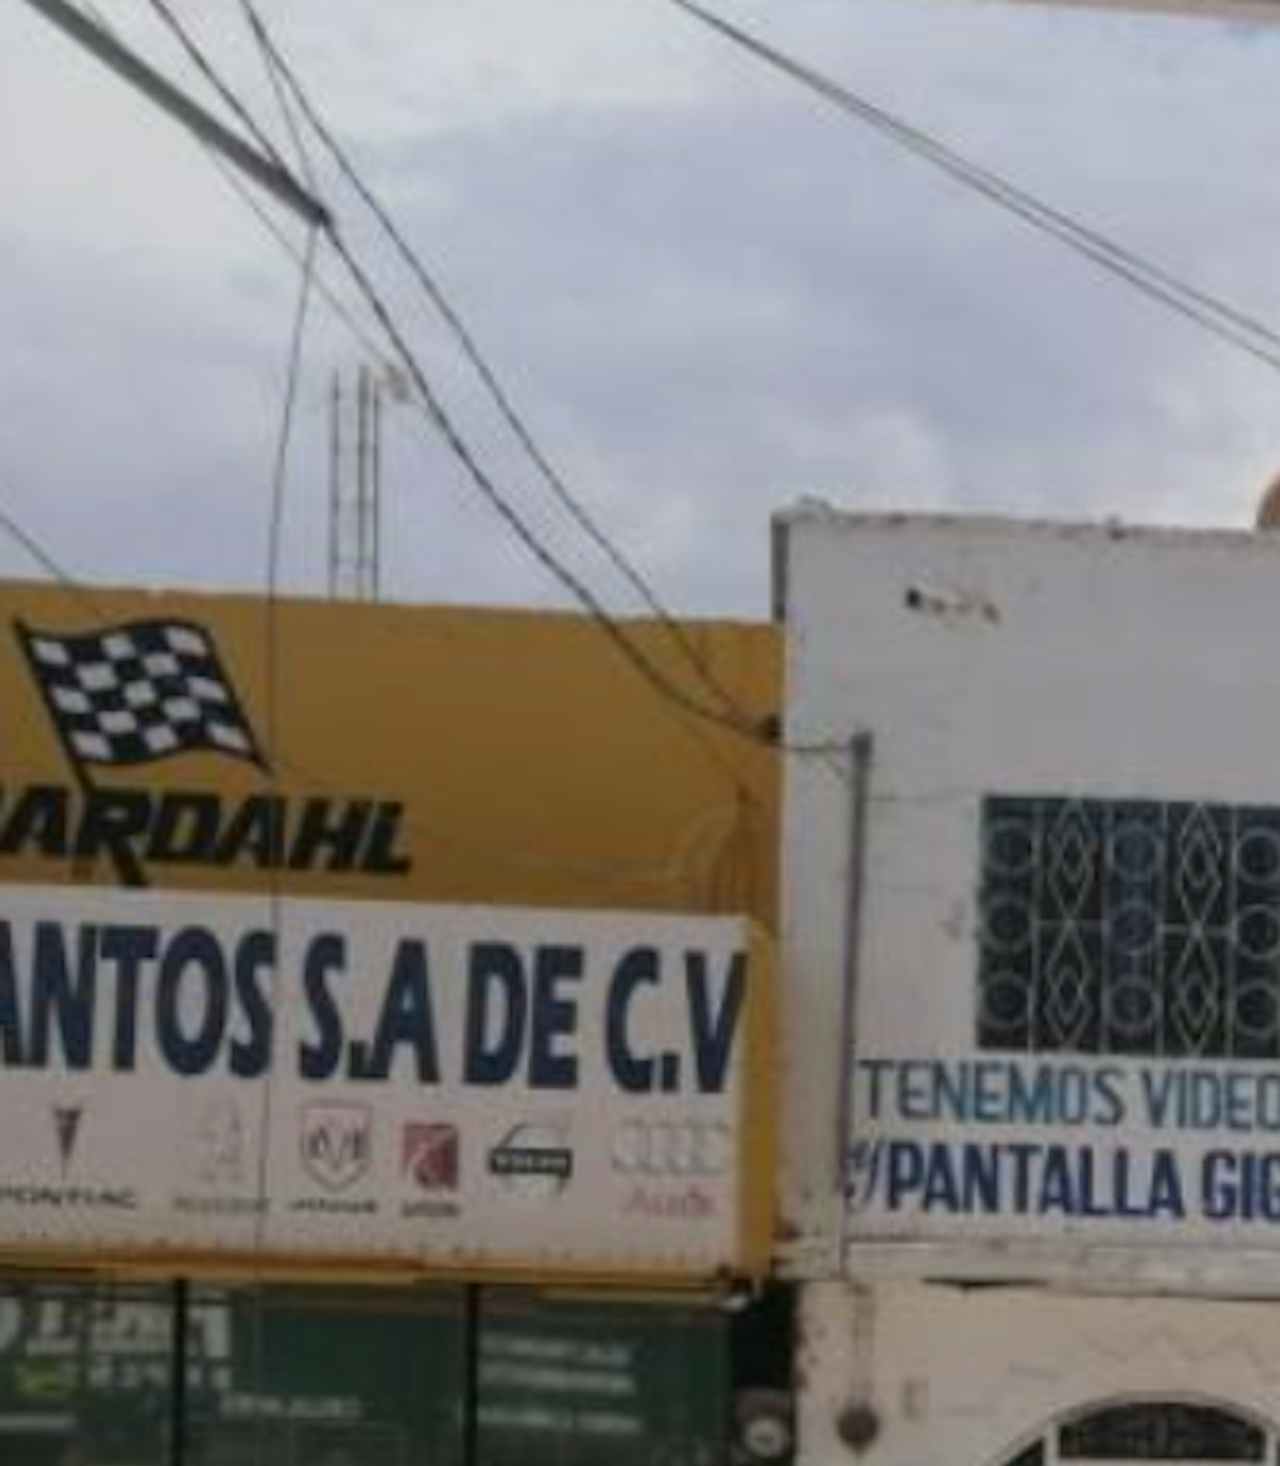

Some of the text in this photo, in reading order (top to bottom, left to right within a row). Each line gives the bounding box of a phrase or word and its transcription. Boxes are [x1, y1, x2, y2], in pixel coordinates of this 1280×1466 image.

[0, 785, 412, 886] ARDAHL
[299, 933, 440, 1083] S.A
[463, 942, 584, 1089] DE
[606, 946, 747, 1093] C.V
[858, 1058, 1126, 1127] TENEMOS
